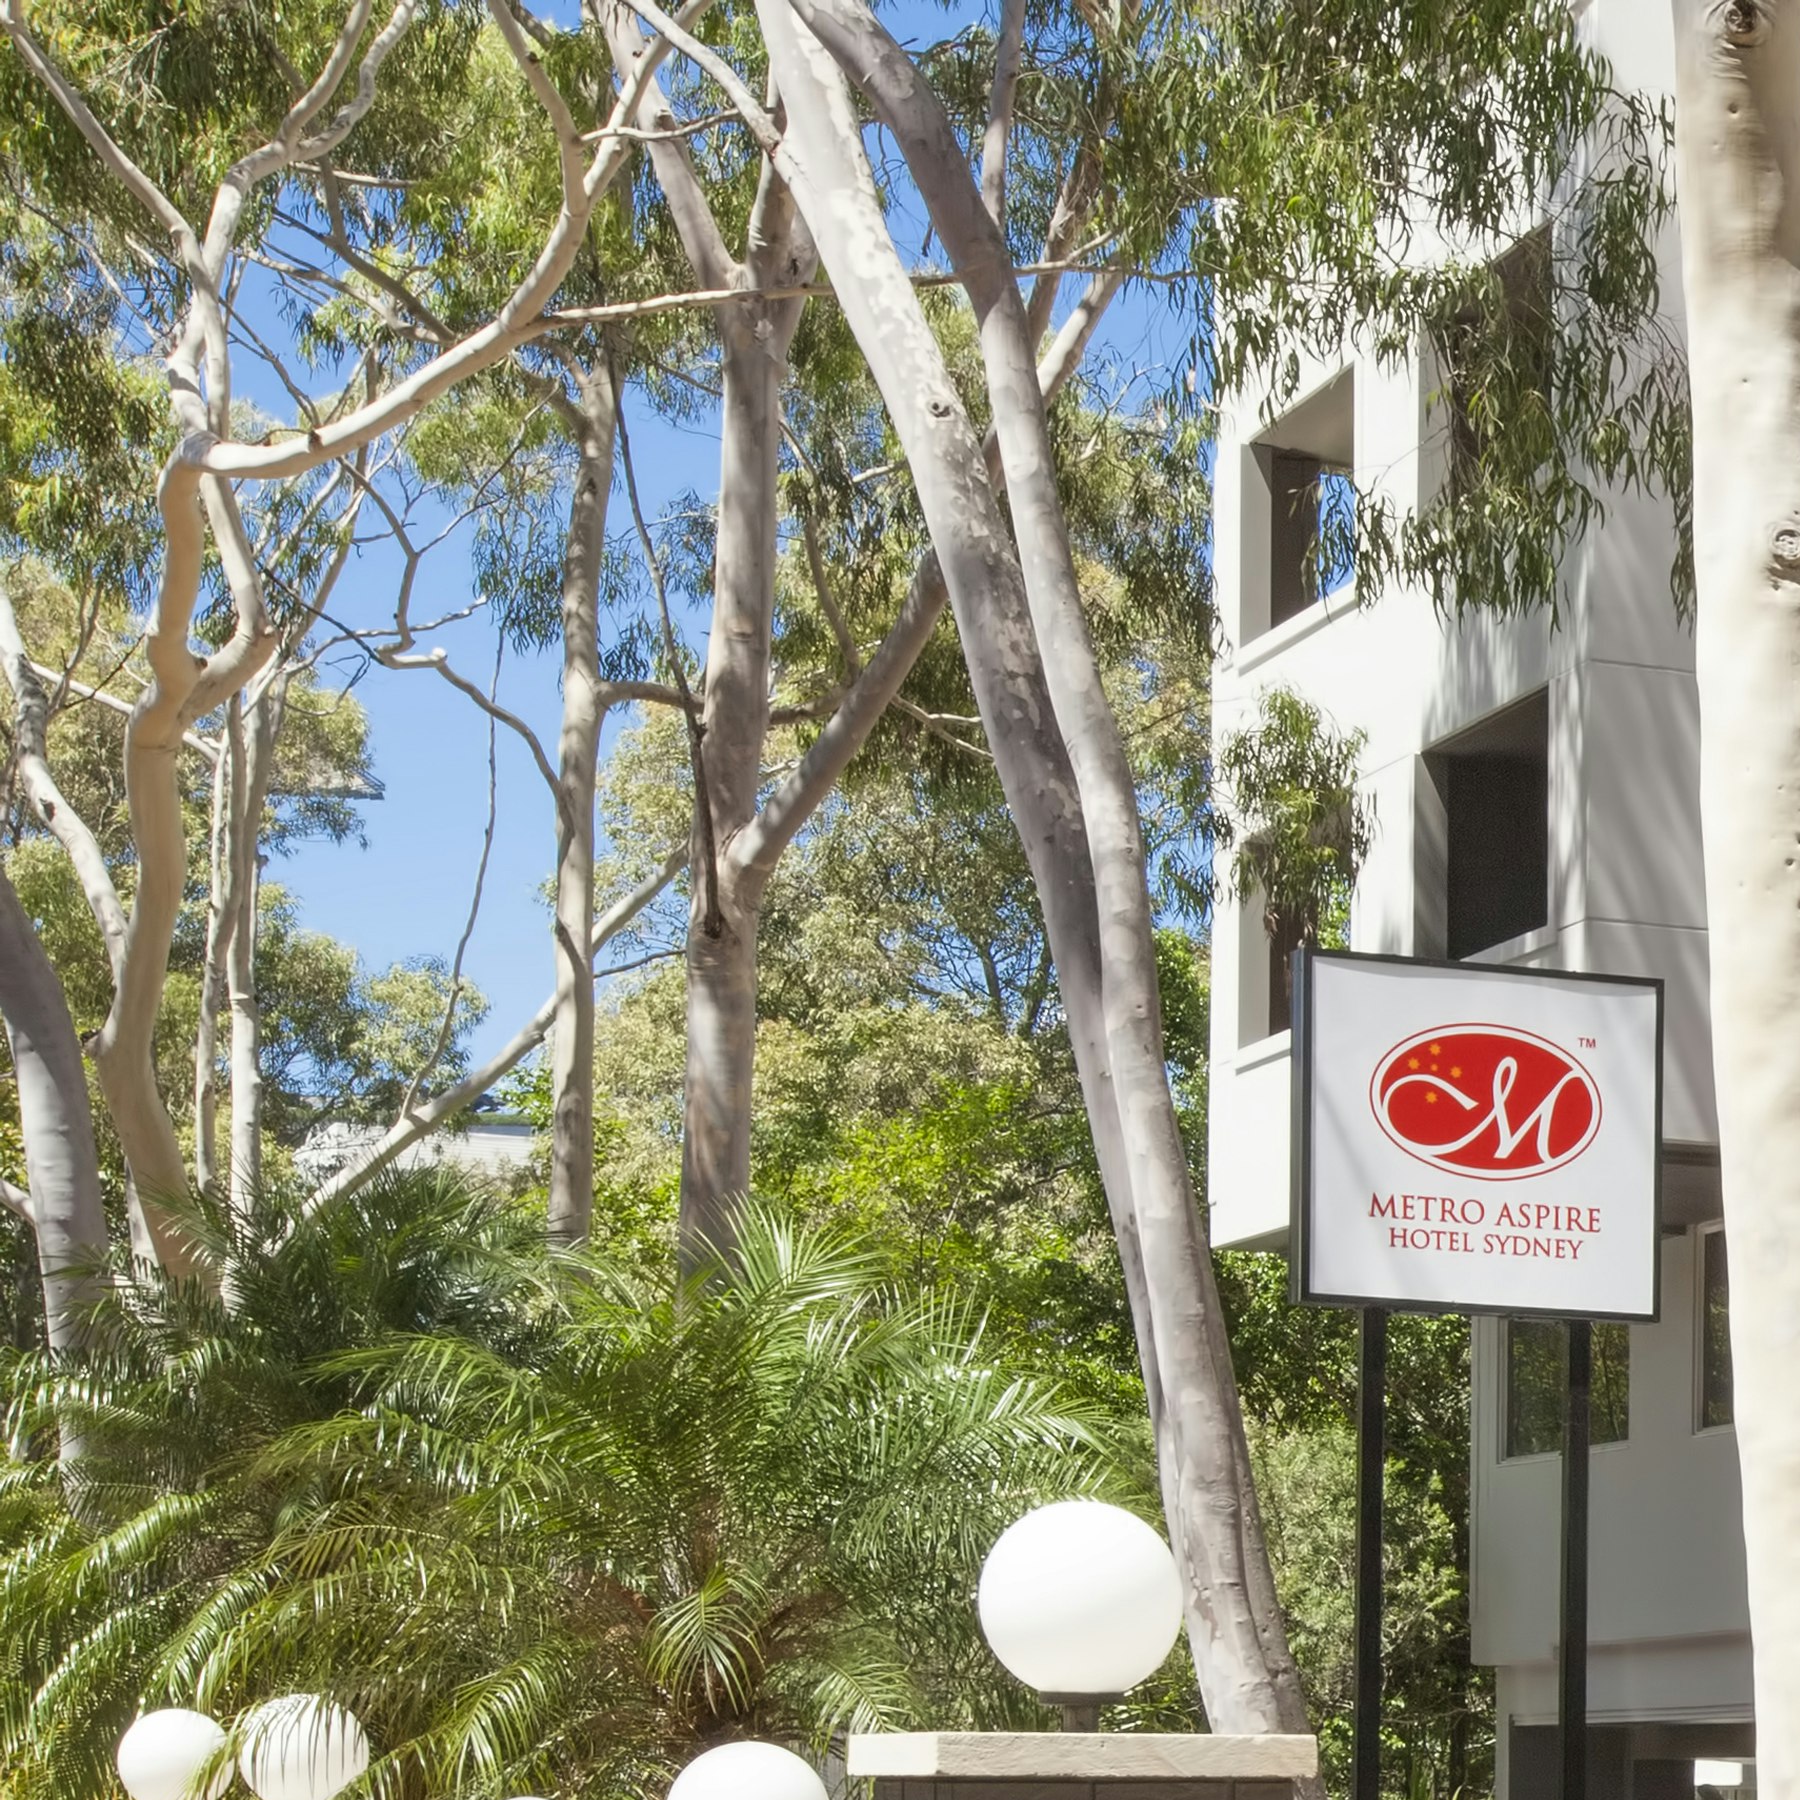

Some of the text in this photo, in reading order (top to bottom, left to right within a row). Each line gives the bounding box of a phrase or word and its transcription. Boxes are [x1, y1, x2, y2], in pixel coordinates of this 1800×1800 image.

[1368, 1192, 1602, 1234] METRO ASPIRE
[1388, 1227, 1584, 1260] HOTEL SYDNEY
